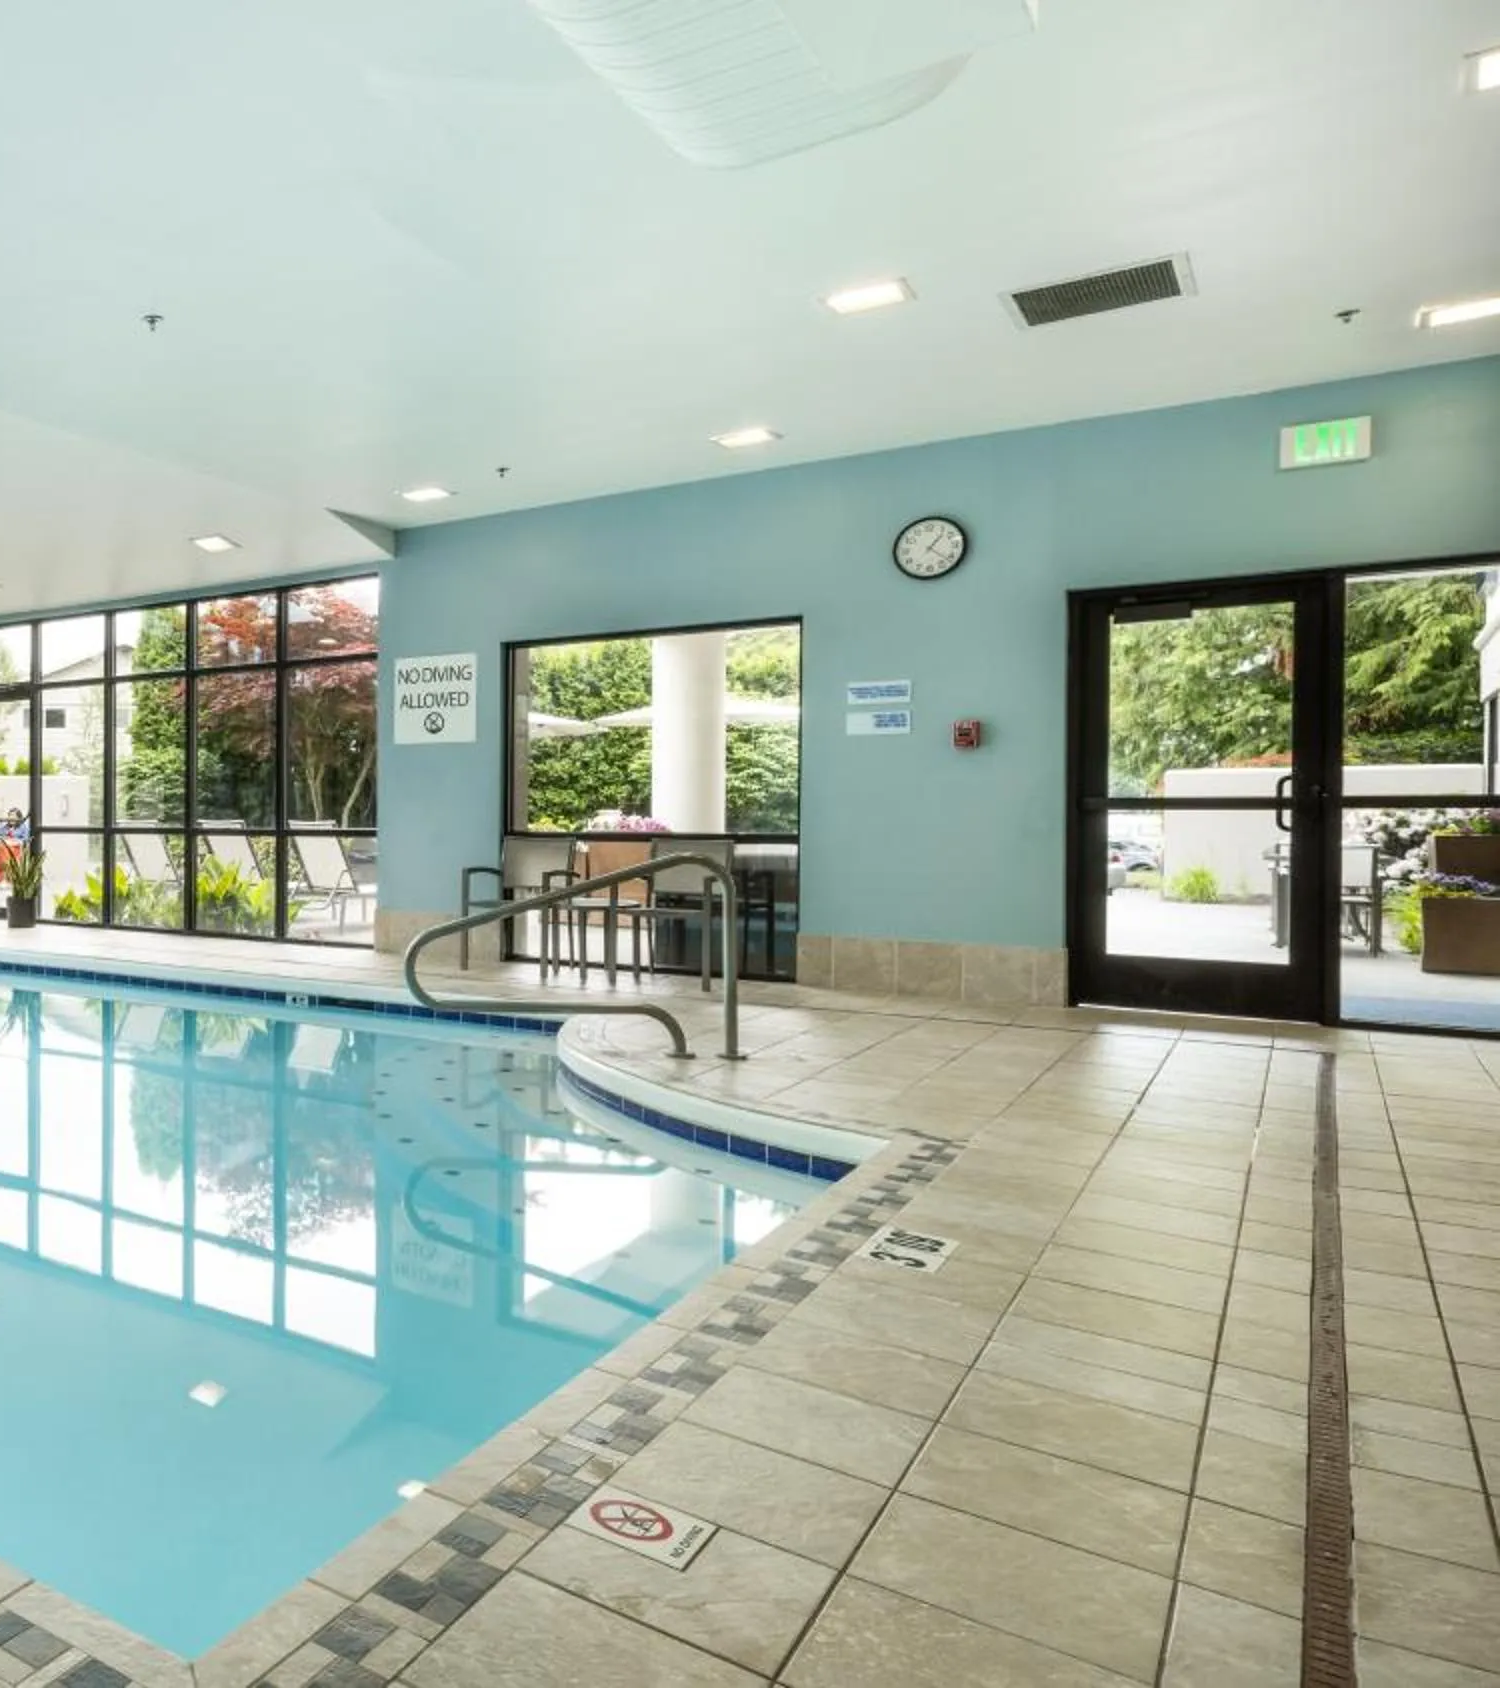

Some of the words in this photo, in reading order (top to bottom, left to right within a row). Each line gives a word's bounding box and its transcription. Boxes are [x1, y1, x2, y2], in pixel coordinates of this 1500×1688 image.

[1294, 419, 1358, 463] EXIT
[397, 667, 420, 684] NO
[421, 664, 473, 683] DIVING
[400, 691, 469, 709] ALLOWED
[869, 1251, 927, 1268] 3
